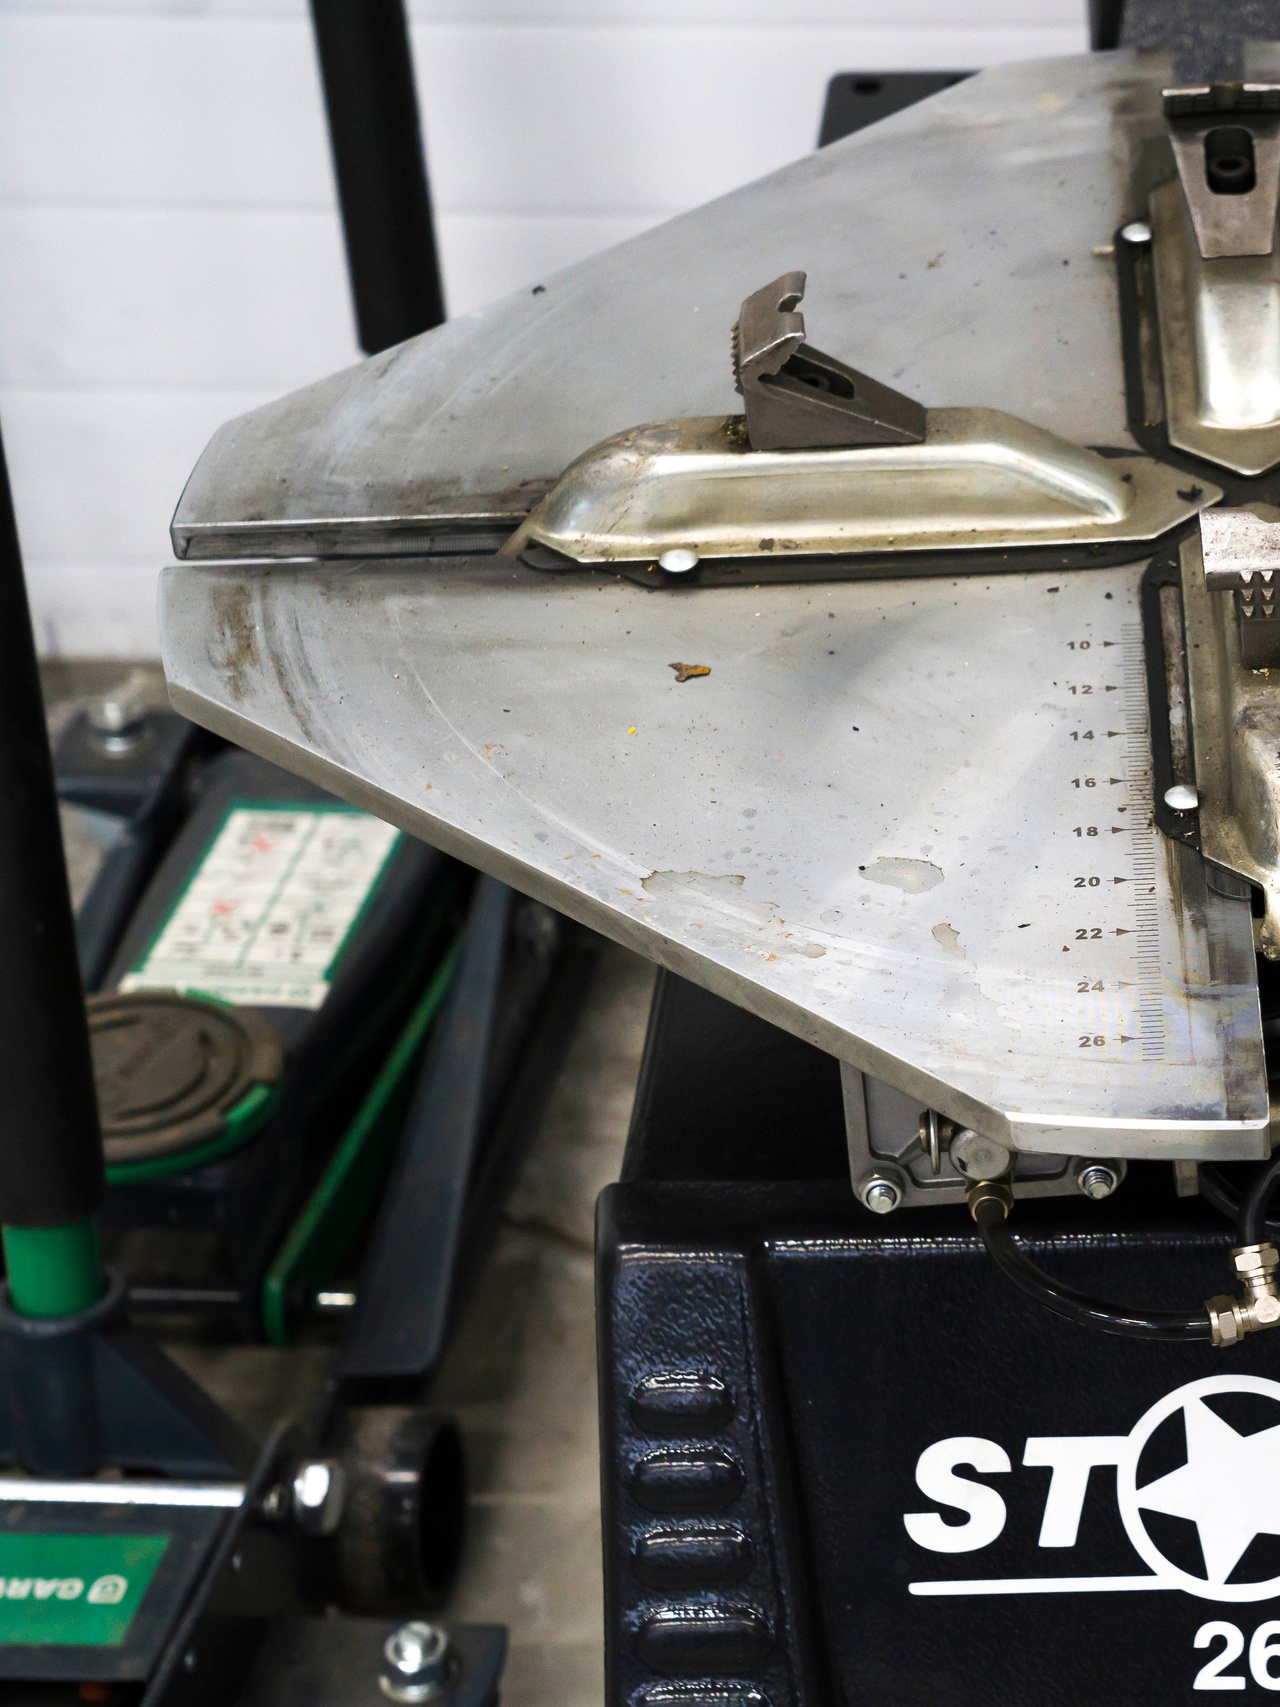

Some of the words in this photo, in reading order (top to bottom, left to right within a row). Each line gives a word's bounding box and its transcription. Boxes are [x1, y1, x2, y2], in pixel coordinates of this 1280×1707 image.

[1066, 640, 1091, 651] 10
[1067, 684, 1094, 696] 12
[1069, 729, 1095, 742] 14
[1070, 777, 1097, 789] 16
[1072, 826, 1099, 838] 18
[1073, 876, 1101, 889] 20
[1074, 927, 1103, 941] 22
[1077, 979, 1105, 994] 24
[1078, 1035, 1106, 1048] 26
